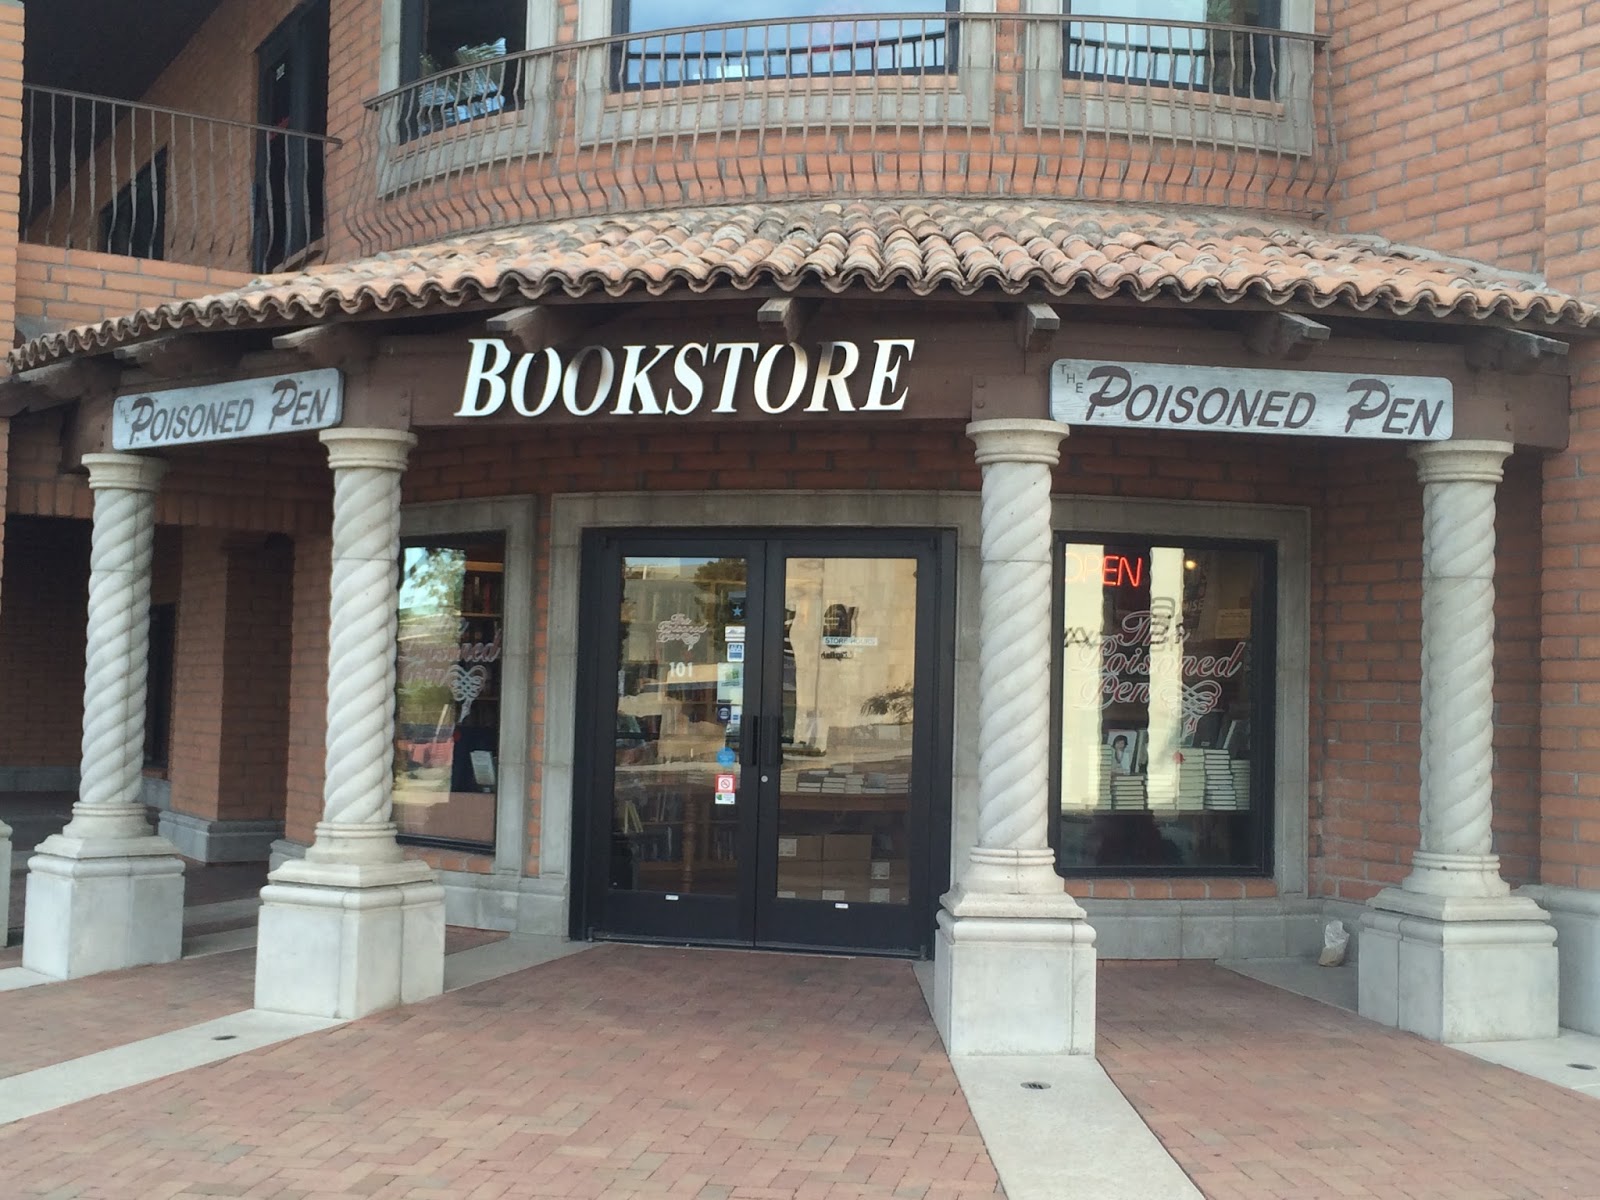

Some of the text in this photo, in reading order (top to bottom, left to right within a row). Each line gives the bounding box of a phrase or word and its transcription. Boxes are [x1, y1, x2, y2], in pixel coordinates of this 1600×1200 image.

[453, 337, 915, 417] BOOKSTORE
[1059, 363, 1443, 436] THE POISONED PEN
[129, 396, 255, 446] POISONED
[268, 378, 331, 431] PEN
[1064, 551, 1143, 588] OPEN
[669, 661, 694, 678] 101
